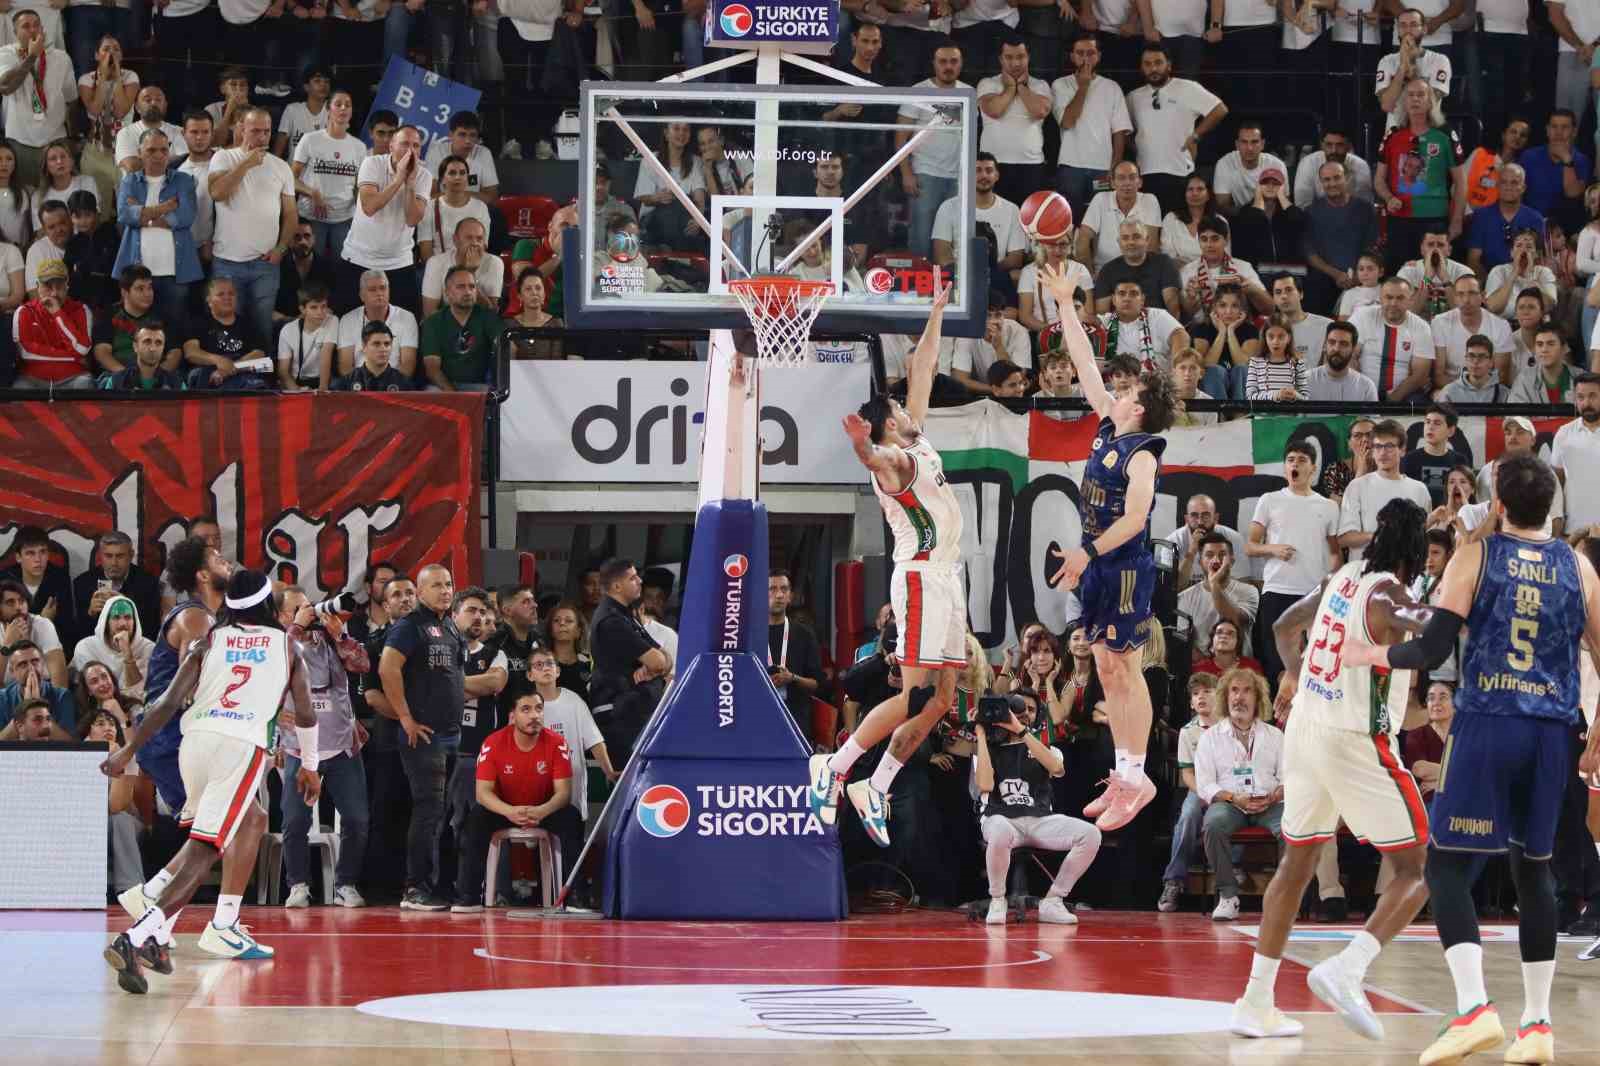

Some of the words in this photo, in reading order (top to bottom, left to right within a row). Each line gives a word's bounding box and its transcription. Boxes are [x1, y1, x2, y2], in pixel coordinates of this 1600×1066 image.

[226, 635, 271, 650] WEBER
[1507, 616, 1540, 673] 5
[220, 664, 253, 710] 2
